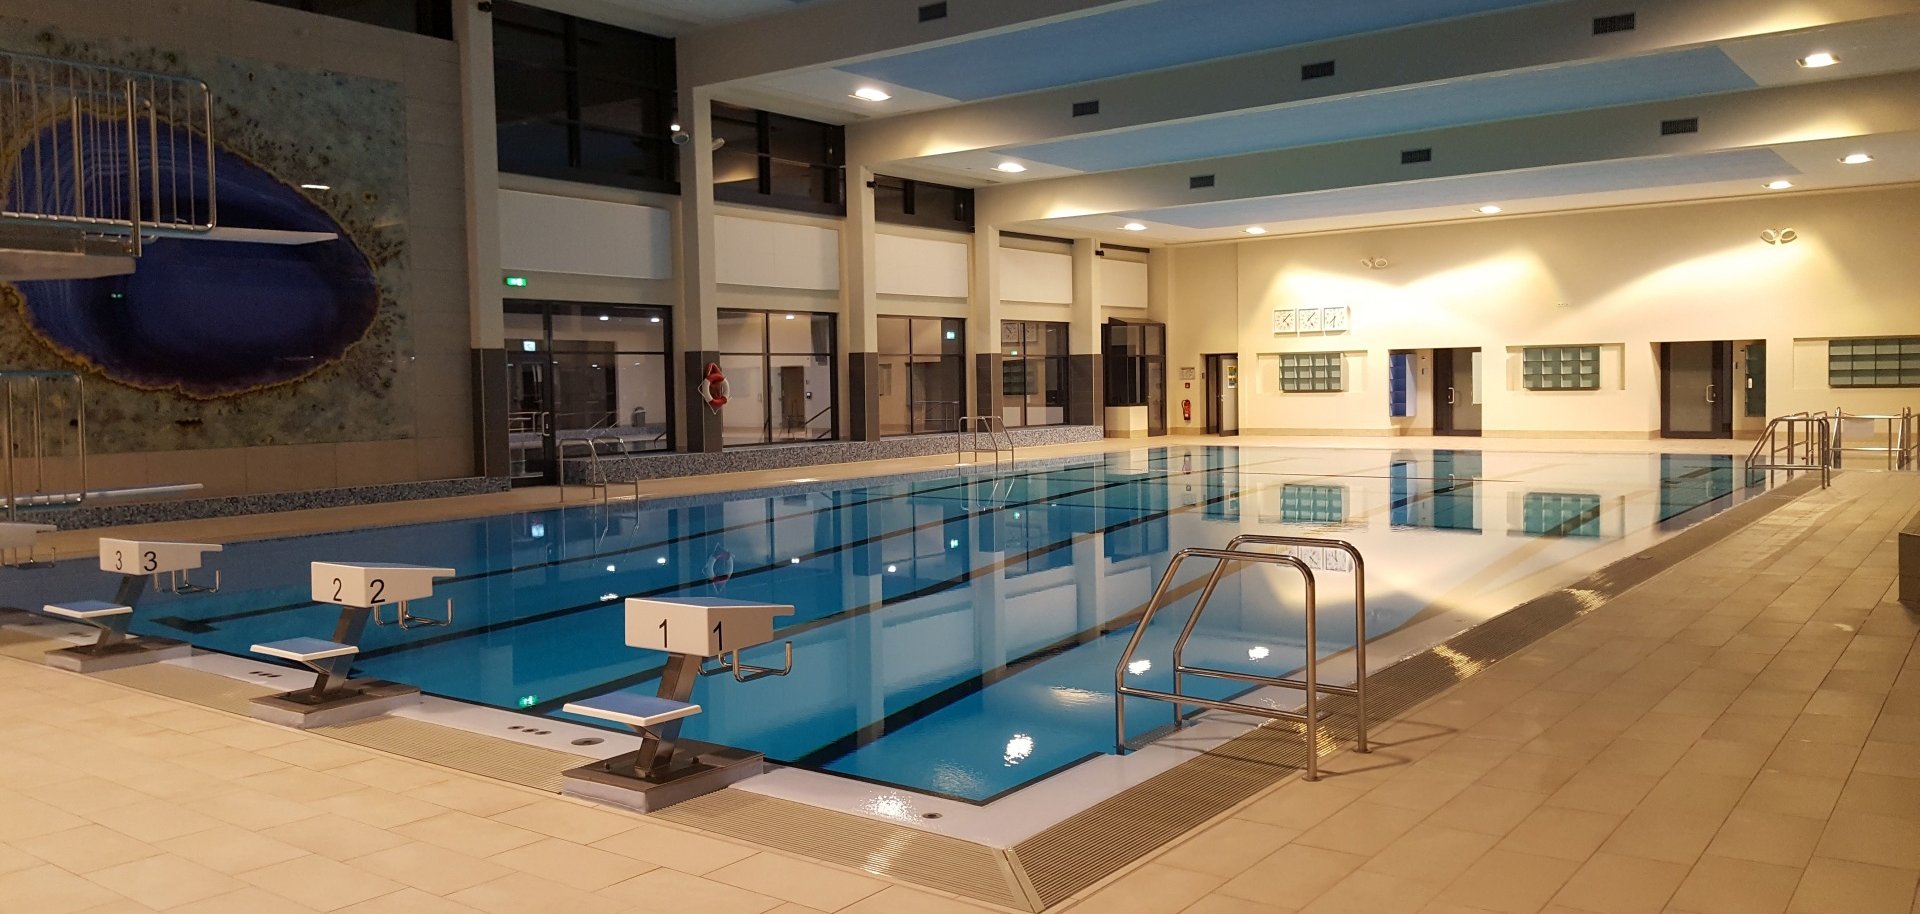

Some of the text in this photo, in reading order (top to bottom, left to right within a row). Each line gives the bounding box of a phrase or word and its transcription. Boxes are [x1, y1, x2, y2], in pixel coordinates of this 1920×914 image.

[115, 550, 123, 571] 3
[143, 551, 158, 572] 3
[333, 577, 342, 602] 2
[369, 578, 386, 605] 2
[659, 618, 668, 649] 1
[713, 620, 723, 652] 1
